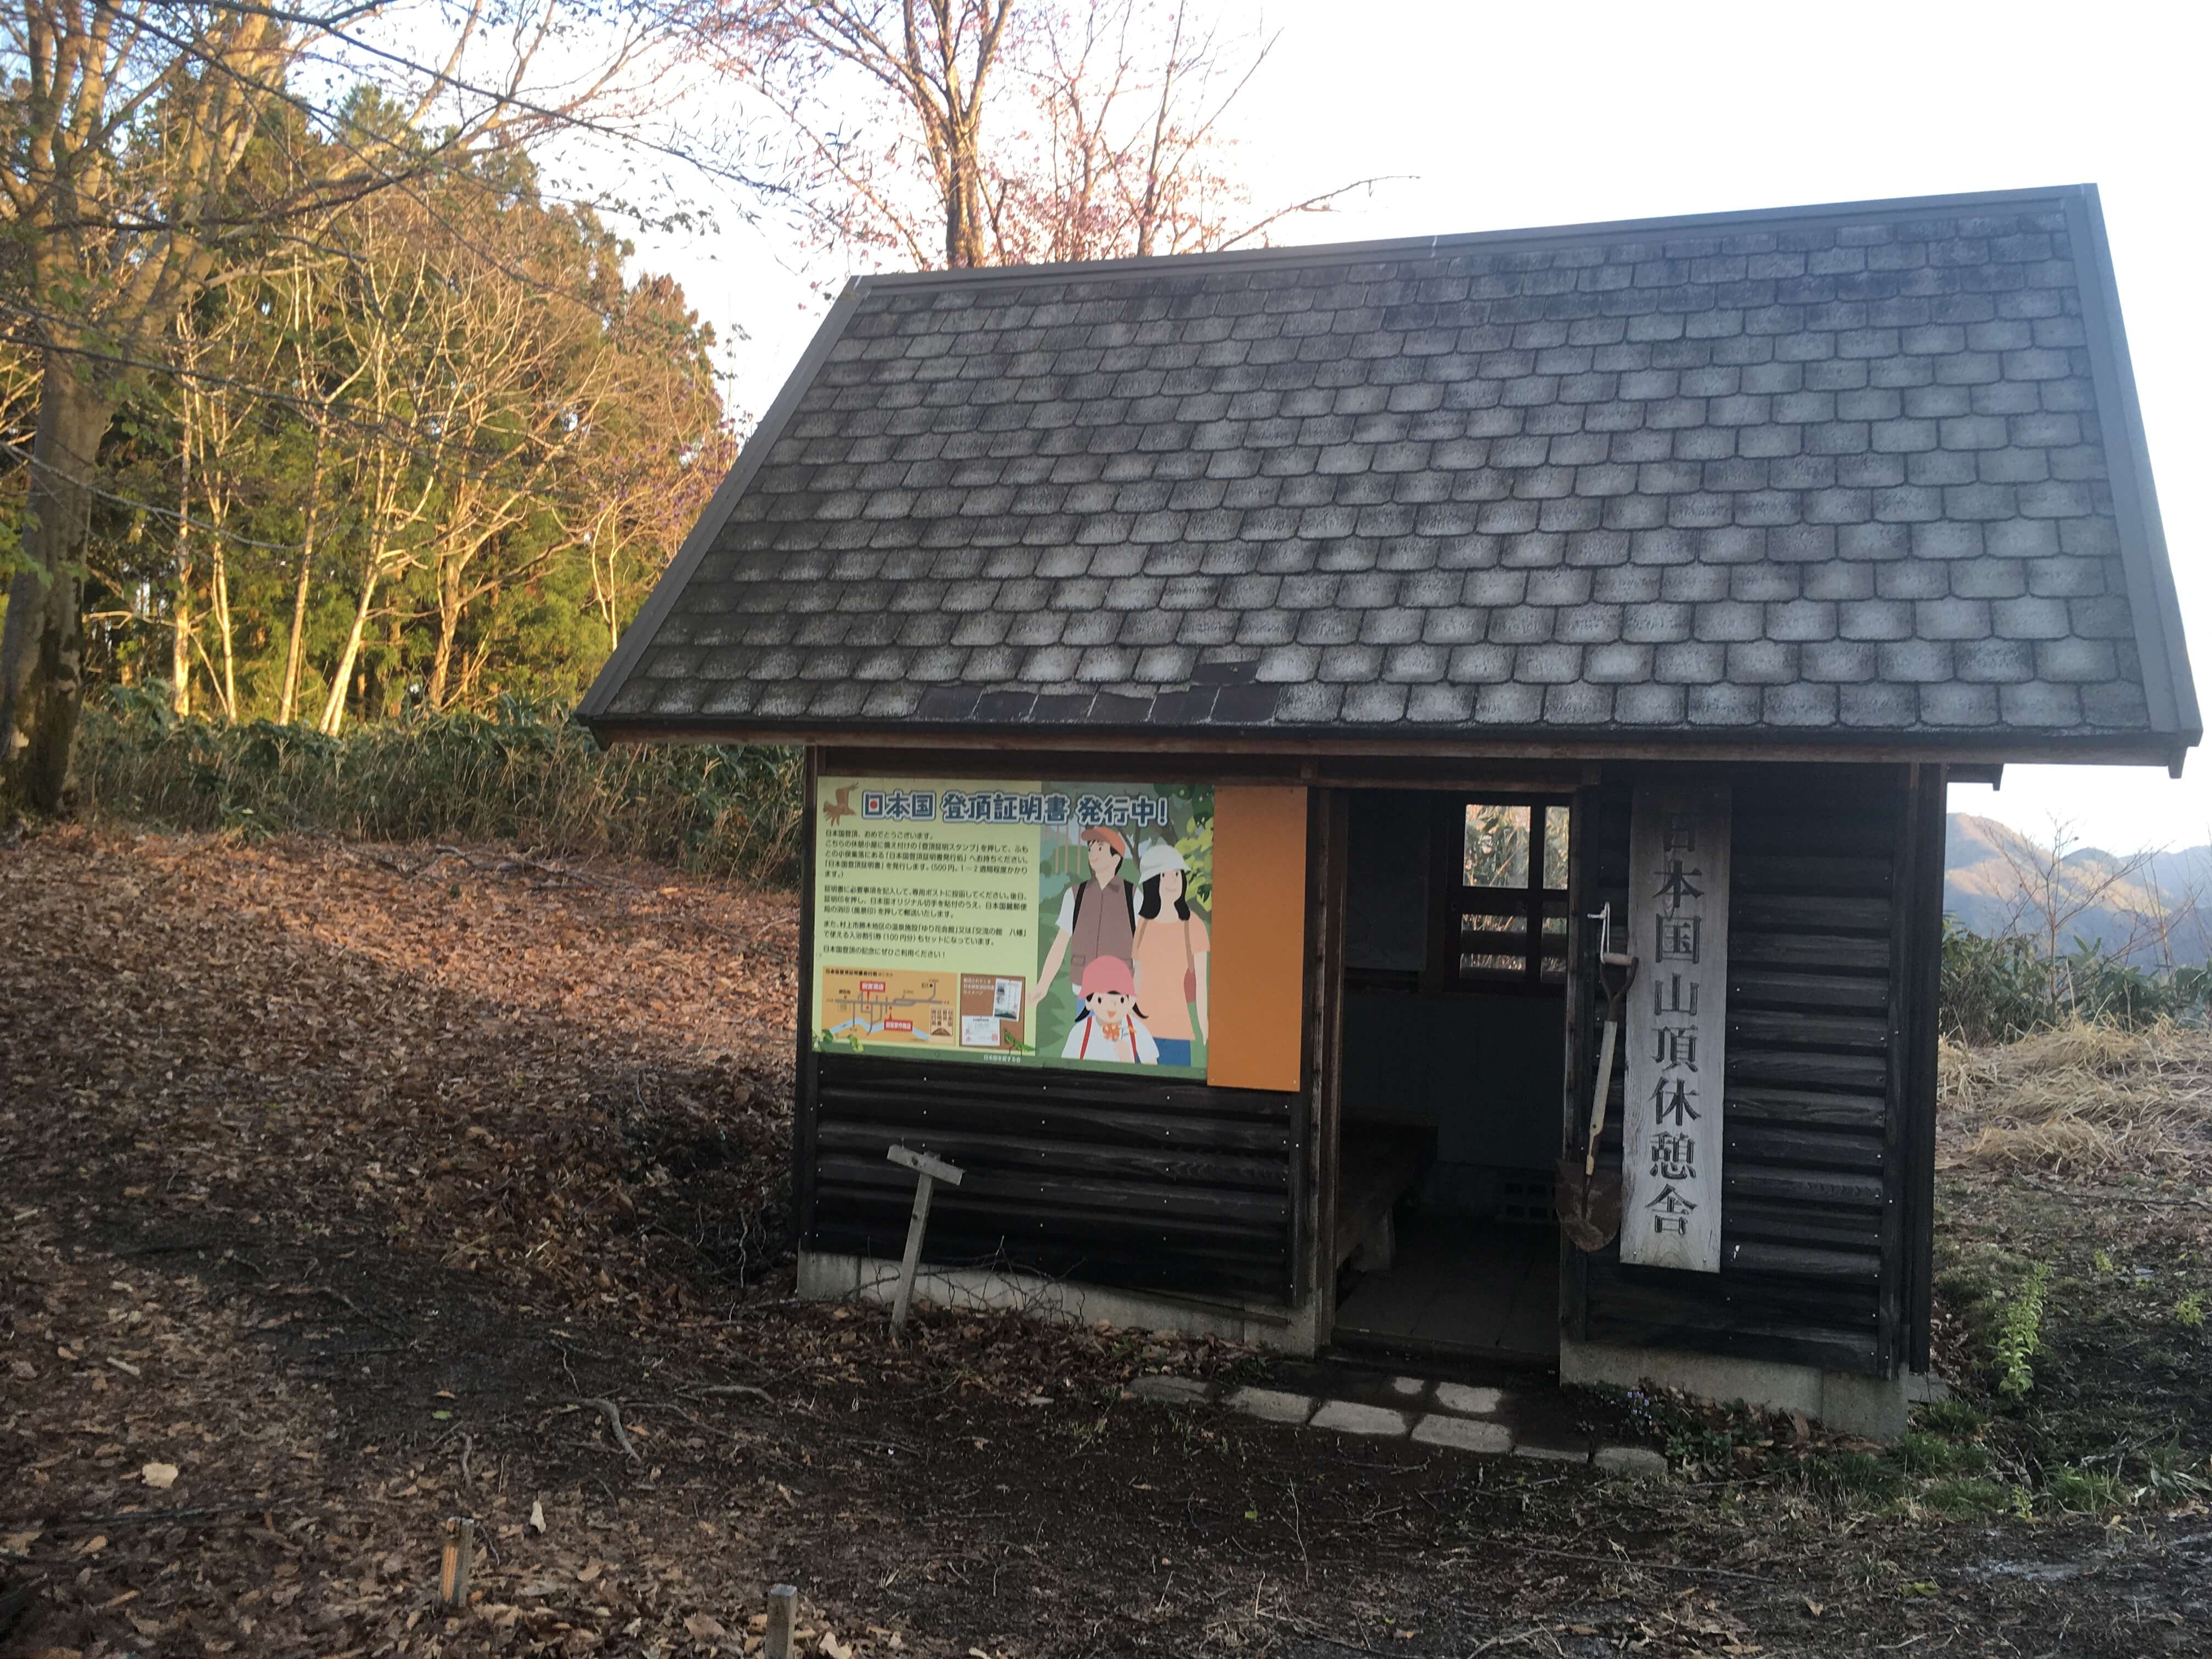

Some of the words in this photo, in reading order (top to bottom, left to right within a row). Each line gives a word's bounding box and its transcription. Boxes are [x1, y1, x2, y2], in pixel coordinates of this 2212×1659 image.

[862, 789, 936, 821] 日本国
[941, 789, 1070, 825] 登頂証明書
[1075, 793, 1168, 827] 発行中!
[1646, 813, 1704, 1235] 日本国山頂休憩舎
